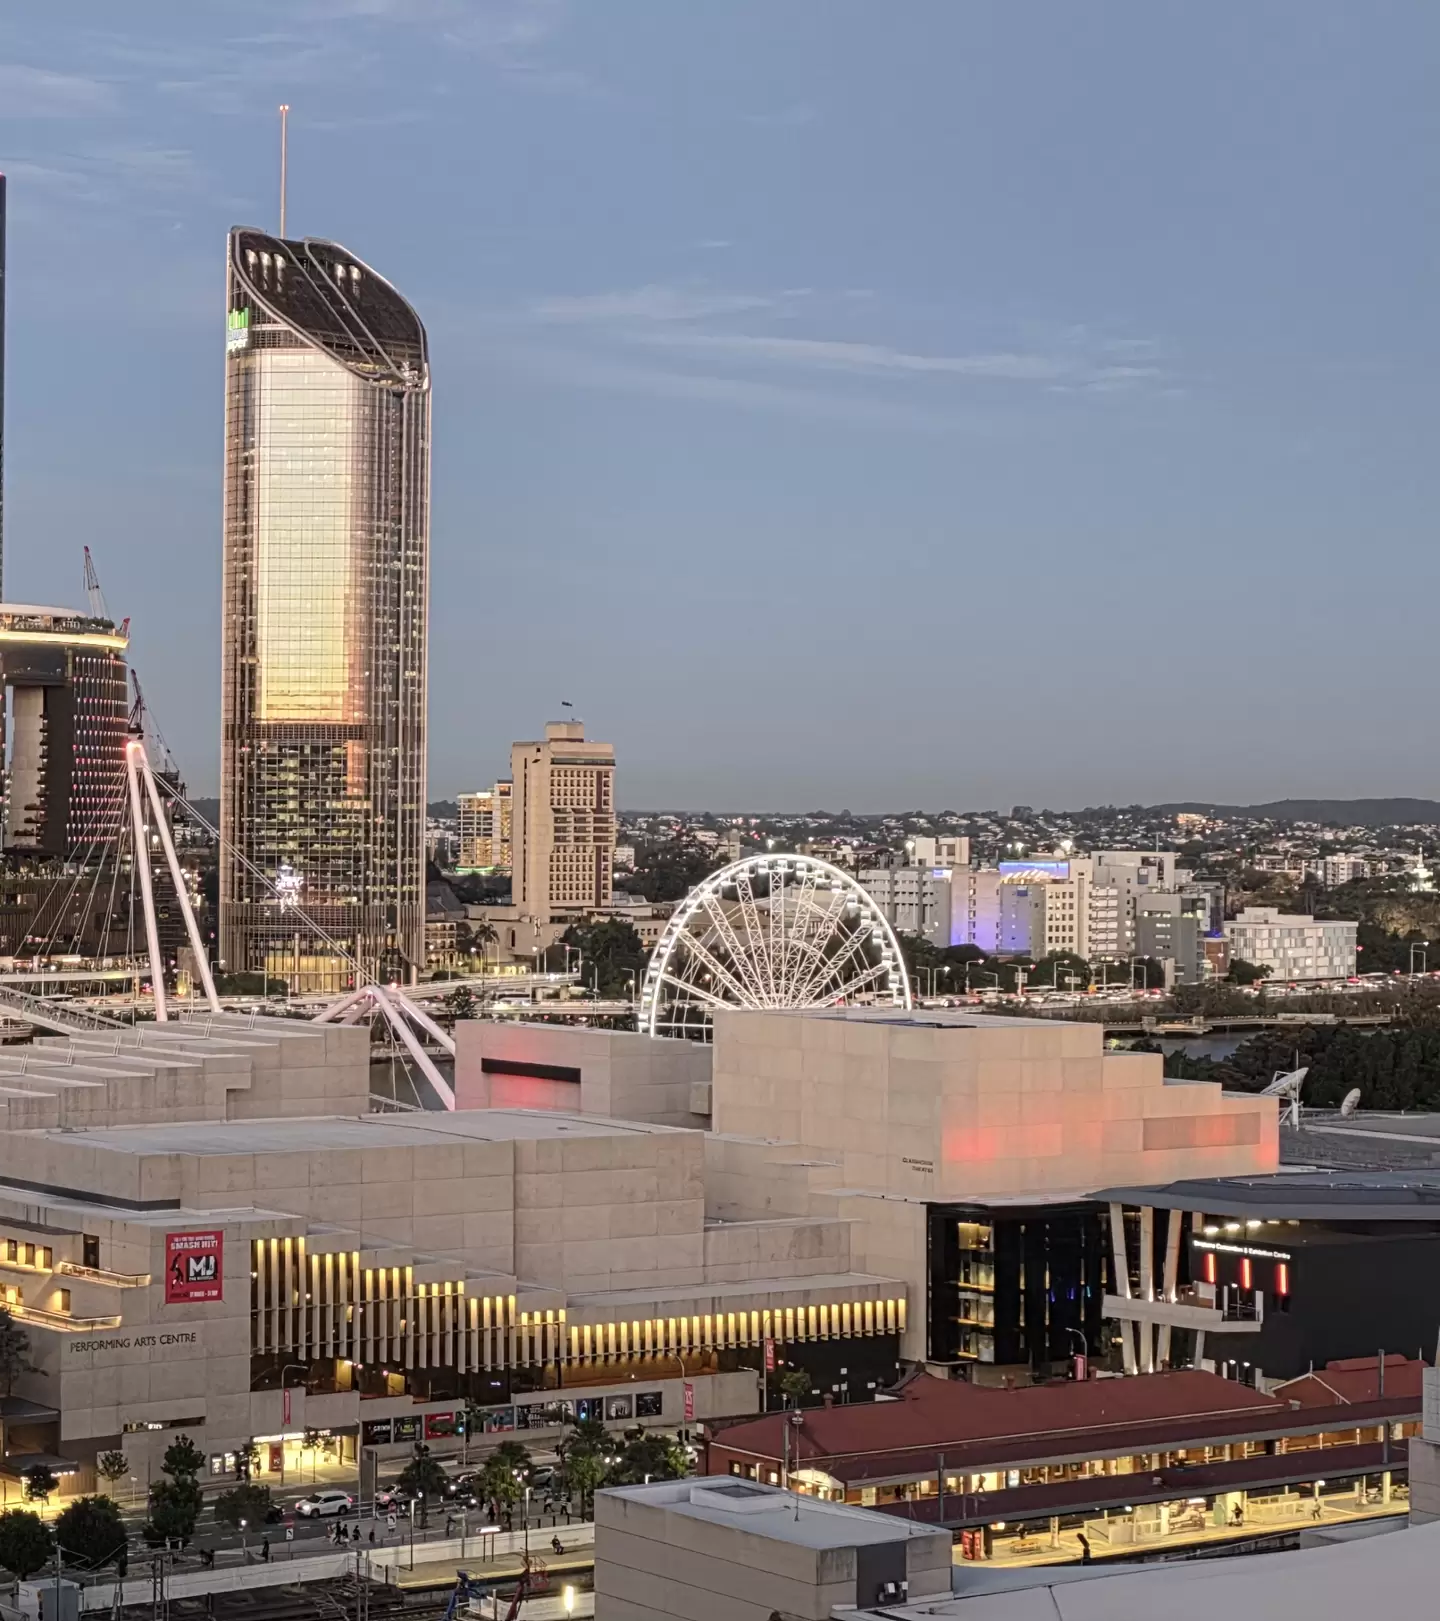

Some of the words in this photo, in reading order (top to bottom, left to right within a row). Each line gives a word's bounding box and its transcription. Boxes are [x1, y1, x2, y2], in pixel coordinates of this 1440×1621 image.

[189, 1256, 215, 1277] MJ
[70, 1338, 130, 1353] PERFORMING
[134, 1336, 156, 1347] ARTS
[159, 1332, 196, 1345] CENTRE
